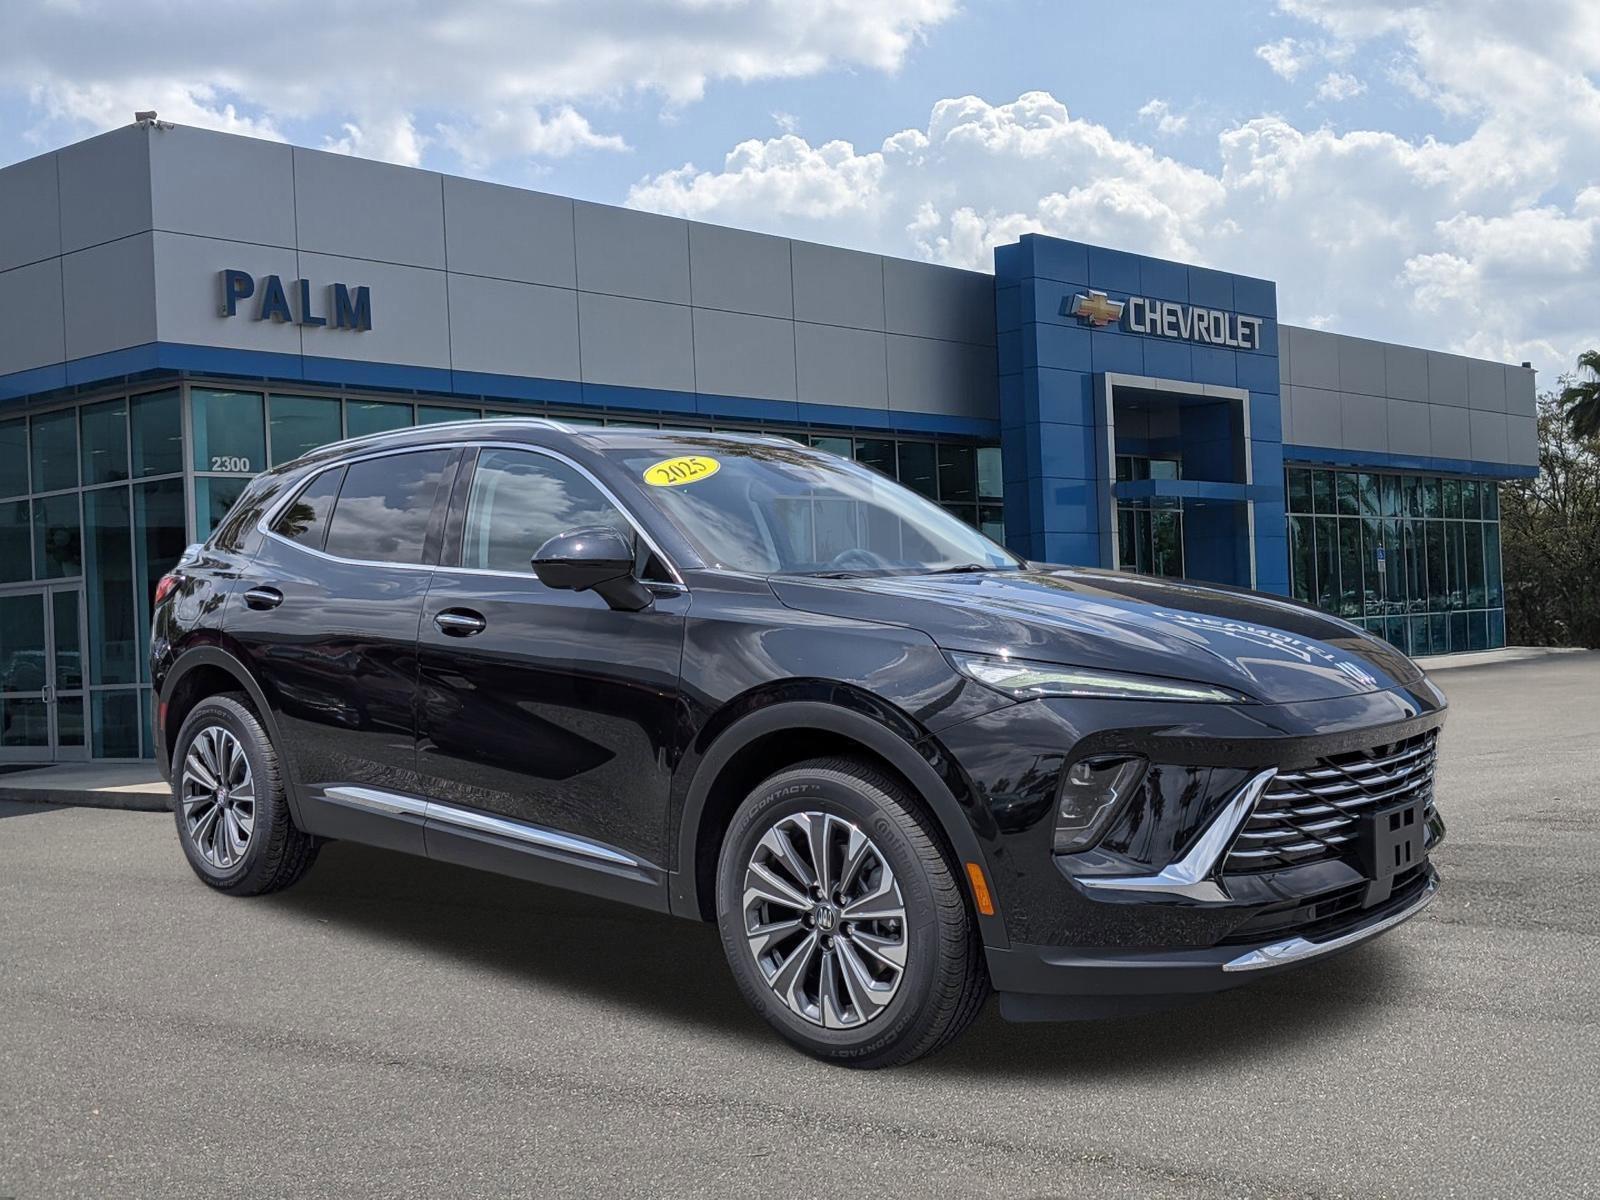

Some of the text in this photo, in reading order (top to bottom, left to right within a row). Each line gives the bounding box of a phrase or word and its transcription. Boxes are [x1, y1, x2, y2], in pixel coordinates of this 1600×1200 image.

[219, 269, 372, 331] PALM
[1129, 297, 1263, 349] CHEVROLET
[212, 456, 249, 471] 2300
[657, 459, 707, 483] 2025
